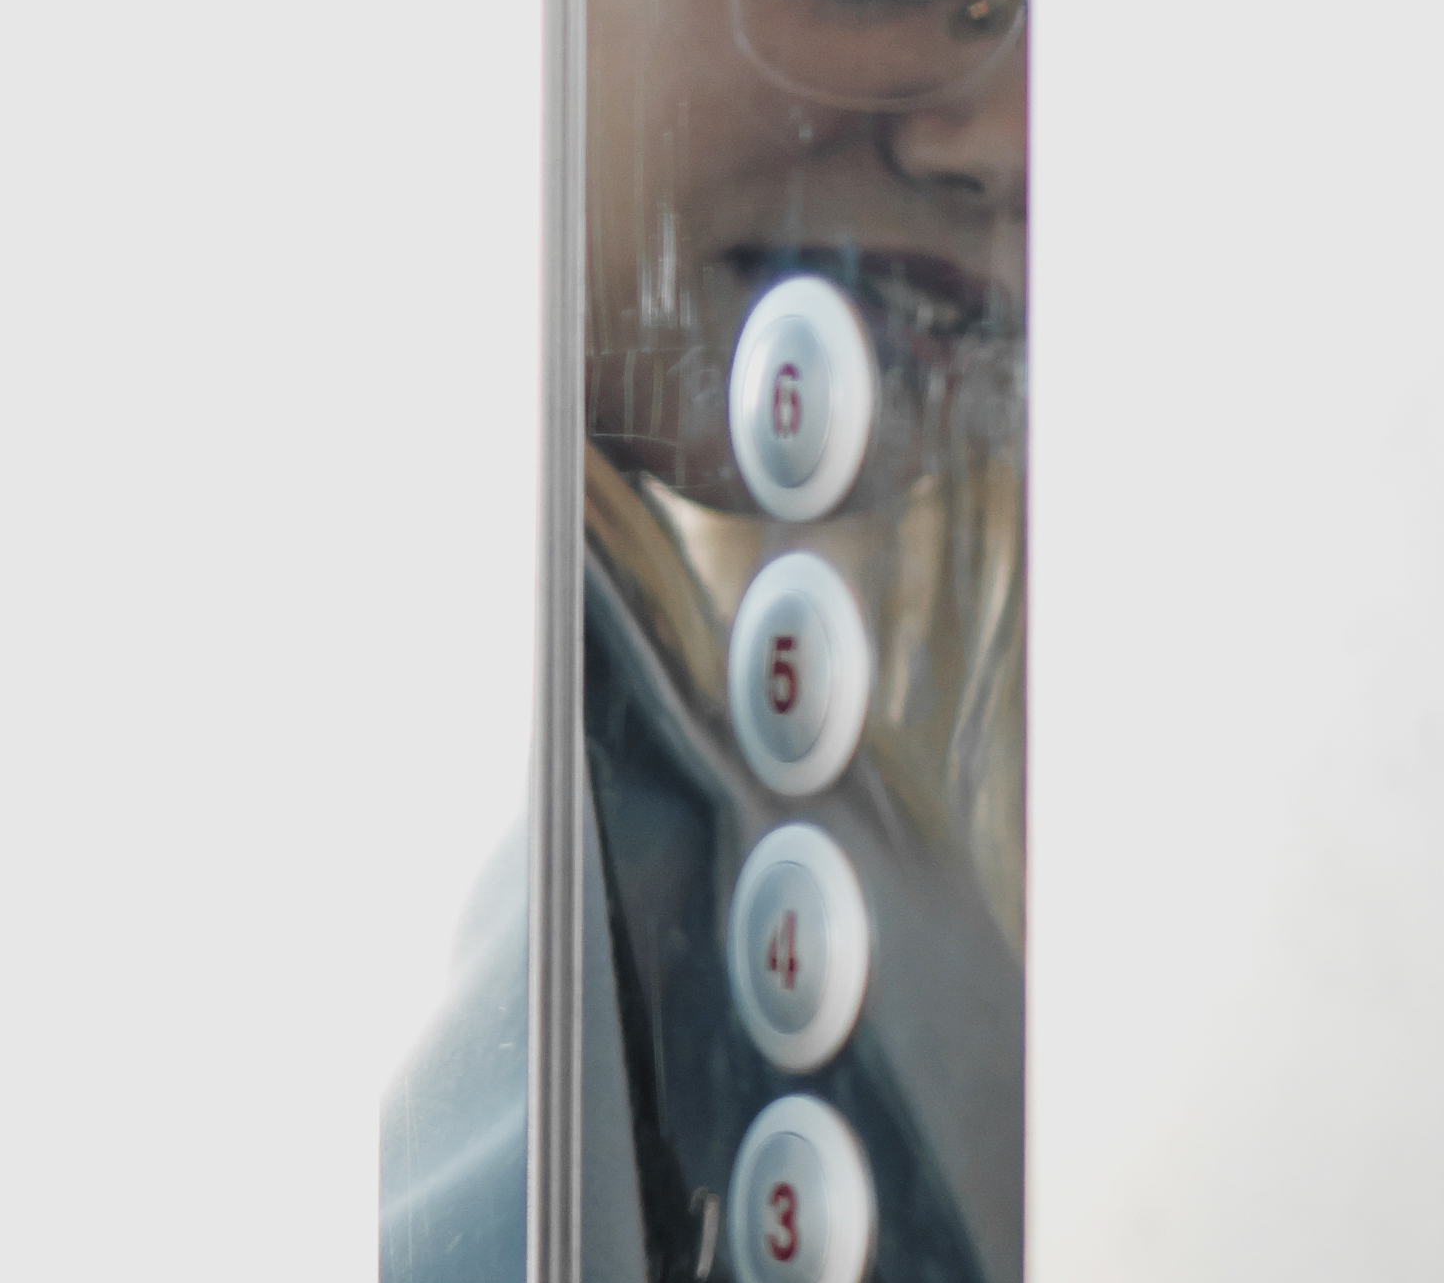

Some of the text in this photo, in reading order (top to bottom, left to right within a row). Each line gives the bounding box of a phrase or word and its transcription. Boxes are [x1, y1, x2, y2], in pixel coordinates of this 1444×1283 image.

[773, 362, 801, 437] 6
[770, 635, 799, 714] 5
[767, 910, 799, 990] 4
[768, 1182, 799, 1263] 3
